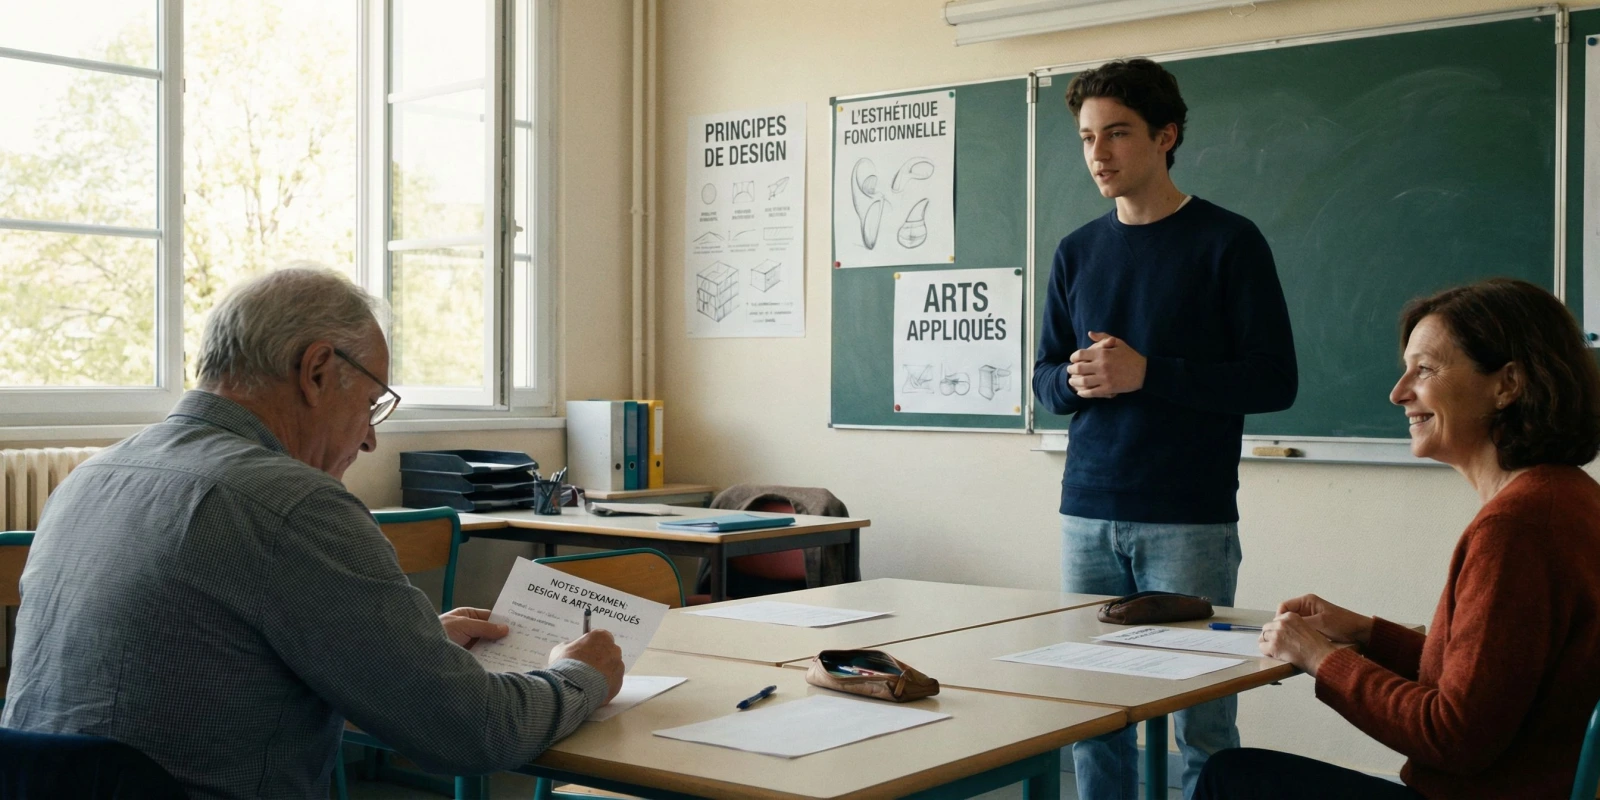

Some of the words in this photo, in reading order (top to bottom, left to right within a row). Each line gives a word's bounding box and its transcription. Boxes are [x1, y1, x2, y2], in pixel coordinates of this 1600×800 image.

[851, 100, 938, 125] L'ESTHÉTIQUE
[705, 114, 787, 143] PRINCIPES
[844, 120, 946, 145] FONCTIONNELLE
[704, 146, 724, 168] DE
[729, 140, 787, 166] DESIGN
[923, 281, 989, 313] ARTS
[906, 313, 1007, 343] APPLIQUÉS
[550, 578, 580, 594] NOTES
[527, 583, 560, 600] DESIGN
[561, 595, 568, 603] &
[569, 598, 592, 610] ARTS
[592, 605, 641, 625] APPLIQUÉS
